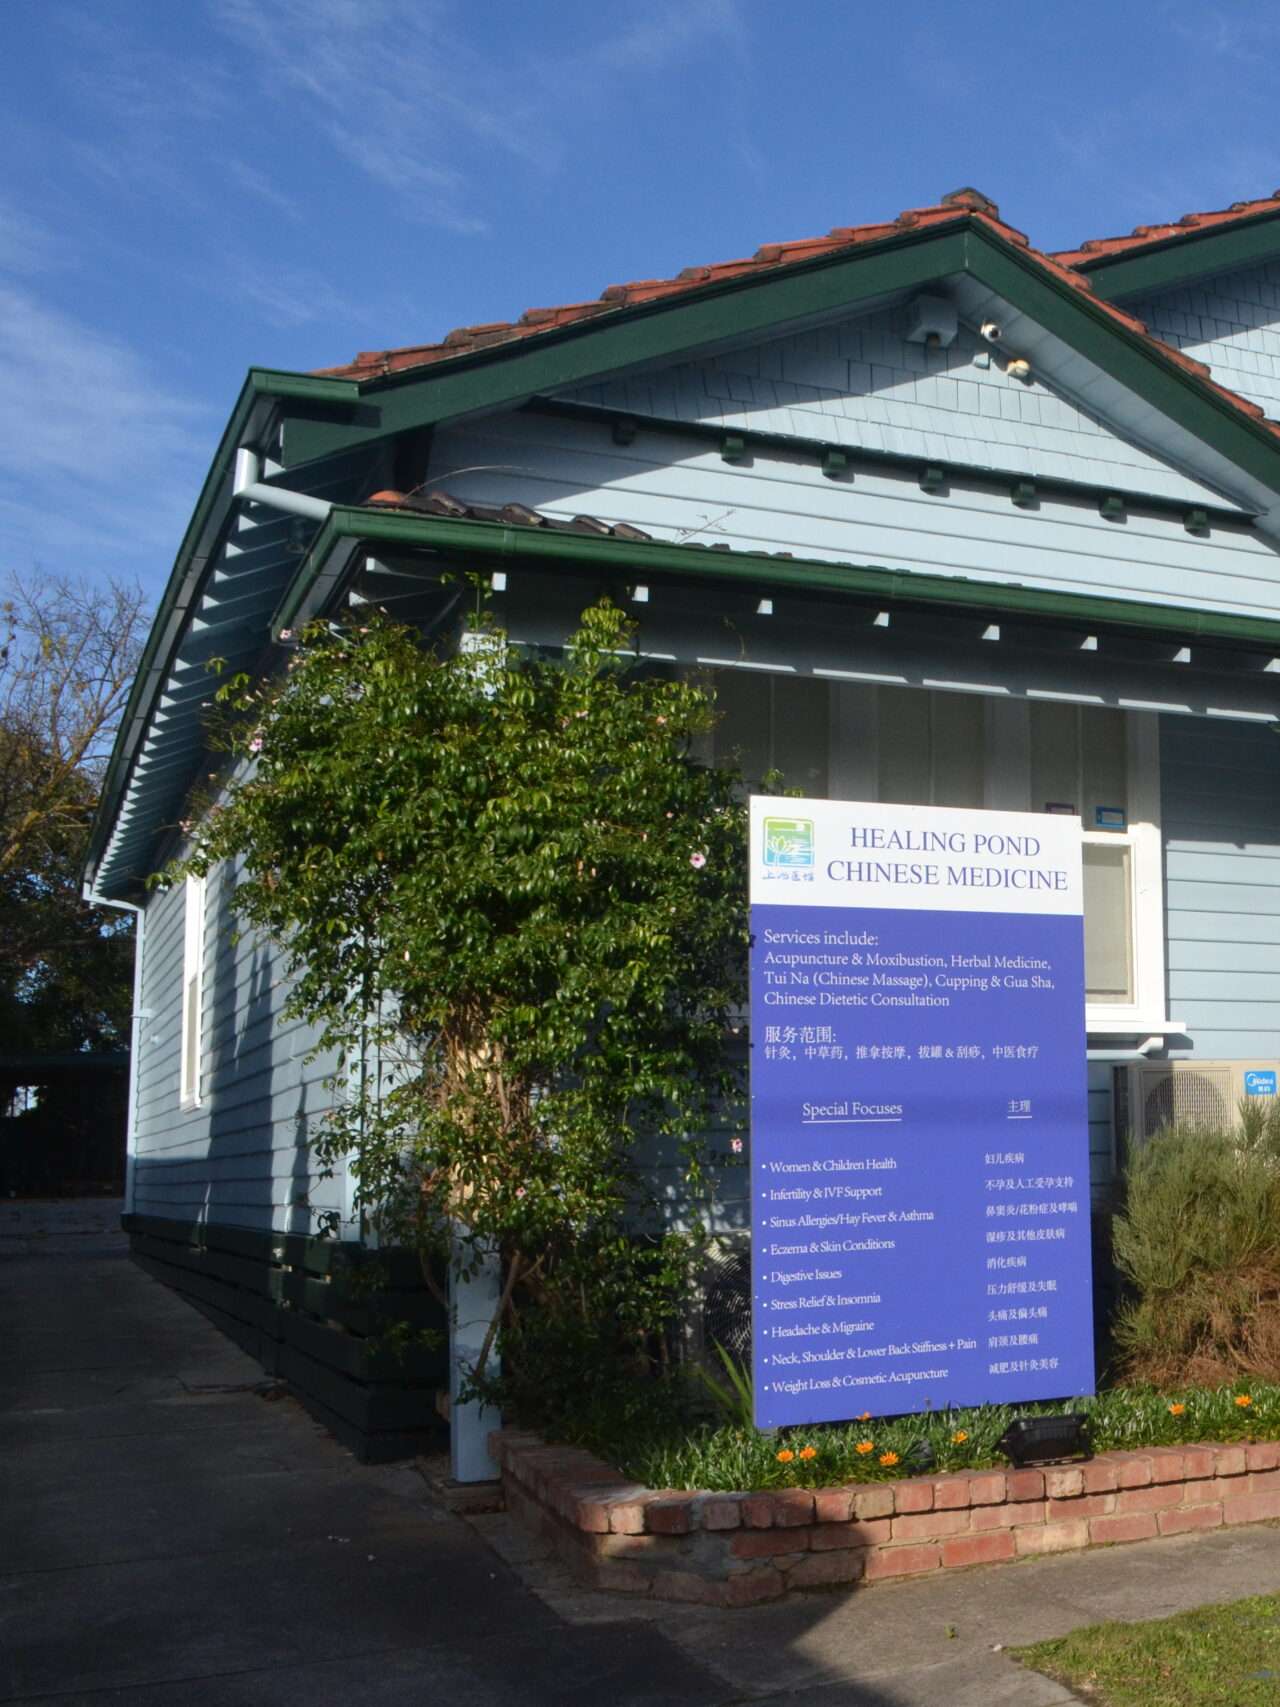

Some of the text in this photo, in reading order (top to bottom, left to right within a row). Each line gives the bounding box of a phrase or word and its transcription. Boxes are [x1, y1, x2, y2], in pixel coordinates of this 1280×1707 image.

[852, 827, 1040, 856] HEALING POND
[827, 861, 1067, 890] CHINESE MEDICINE
[764, 929, 878, 945] Services include:
[764, 952, 1051, 970] Acupuncture & Moxibustion, Herbal Medicine,
[764, 971, 1054, 991] Tui Na (Chinese Massage), Cupping & Gua Sha,
[764, 992, 949, 1006] Chinese Dietetic Consultation
[803, 1102, 902, 1120] Special Focuses
[770, 1158, 896, 1172] Women & Children Health
[771, 1186, 882, 1202] Infertility & IVF Support
[770, 1217, 796, 1228] Sinus
[862, 1213, 887, 1223] Fever
[888, 1212, 897, 1221] &
[899, 1210, 934, 1221] Asthma
[771, 1239, 895, 1255] Eczema & Skin Conditions
[771, 1269, 842, 1285] Digestive Issues
[771, 1293, 880, 1310] Stress Relief & Insomnia
[772, 1320, 874, 1337] Headache & Migraine
[772, 1352, 800, 1365] Neck,
[802, 1349, 845, 1363] Shoulder
[846, 1348, 856, 1359] &
[857, 1347, 887, 1358] Lower
[888, 1343, 911, 1355] Back
[912, 1341, 947, 1353] Stiffness
[957, 1338, 976, 1349] Pain
[772, 1370, 948, 1394] Weight Loss & Cosmetic Acupuncture
